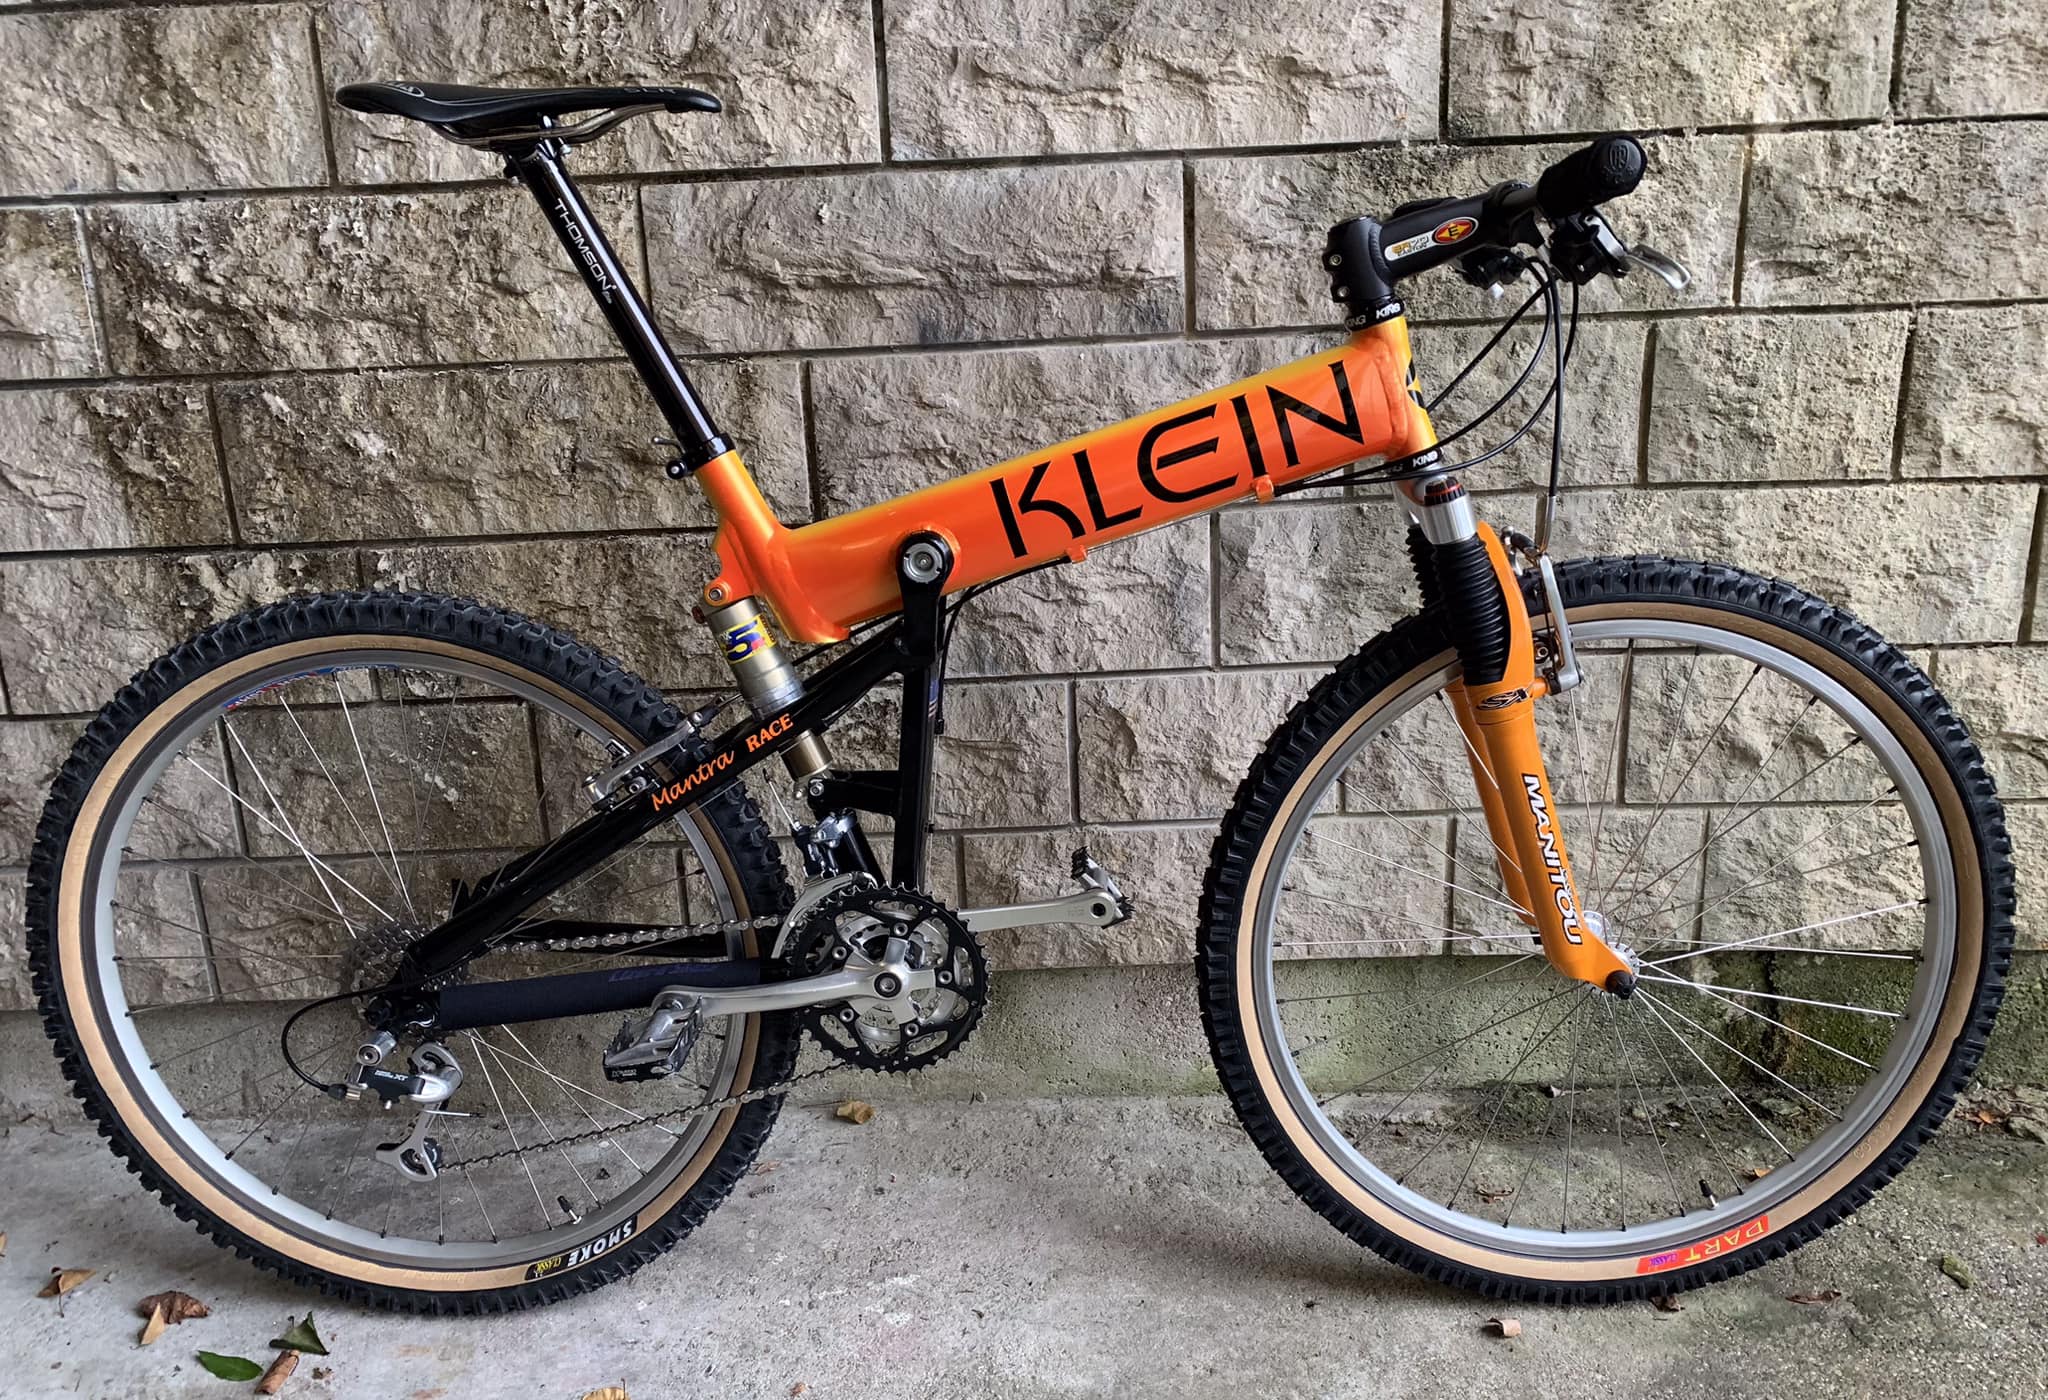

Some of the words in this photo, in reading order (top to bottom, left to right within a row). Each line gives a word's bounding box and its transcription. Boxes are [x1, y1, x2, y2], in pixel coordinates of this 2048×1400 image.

[555, 198, 615, 290] THOMSON
[989, 359, 1364, 558] KLEIN
[652, 750, 735, 811] Mantra
[746, 713, 794, 752] RACE
[1522, 773, 1583, 945] MANITOU
[567, 1219, 633, 1267] SMOKE
[1685, 1220, 1764, 1262] DART
